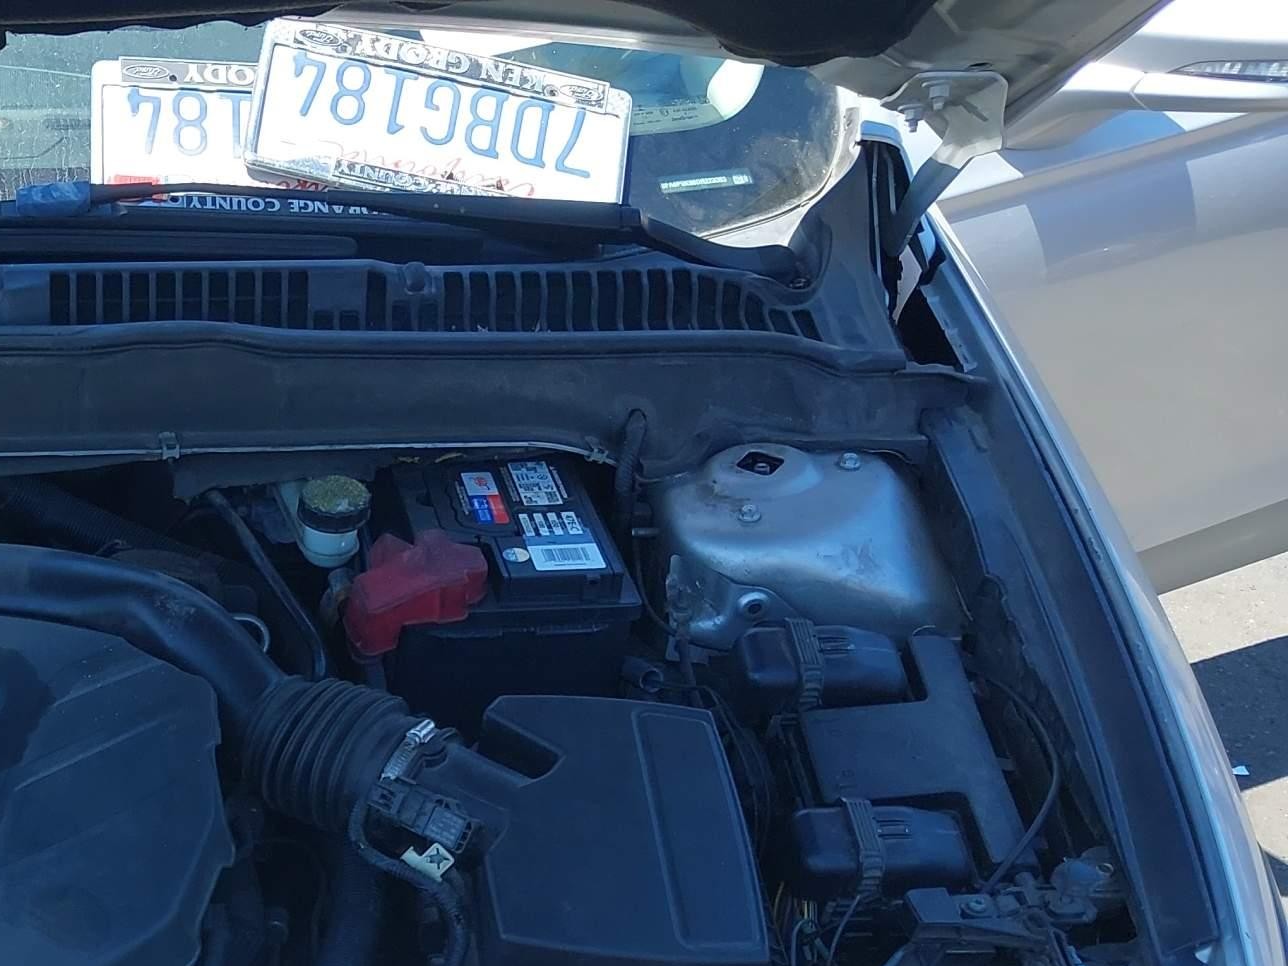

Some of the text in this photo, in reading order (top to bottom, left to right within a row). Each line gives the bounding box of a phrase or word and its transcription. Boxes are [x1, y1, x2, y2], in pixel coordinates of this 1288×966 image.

[479, 59, 546, 95] KEN
[293, 50, 591, 179] 7DBG184
[187, 195, 280, 213] COUNTY
